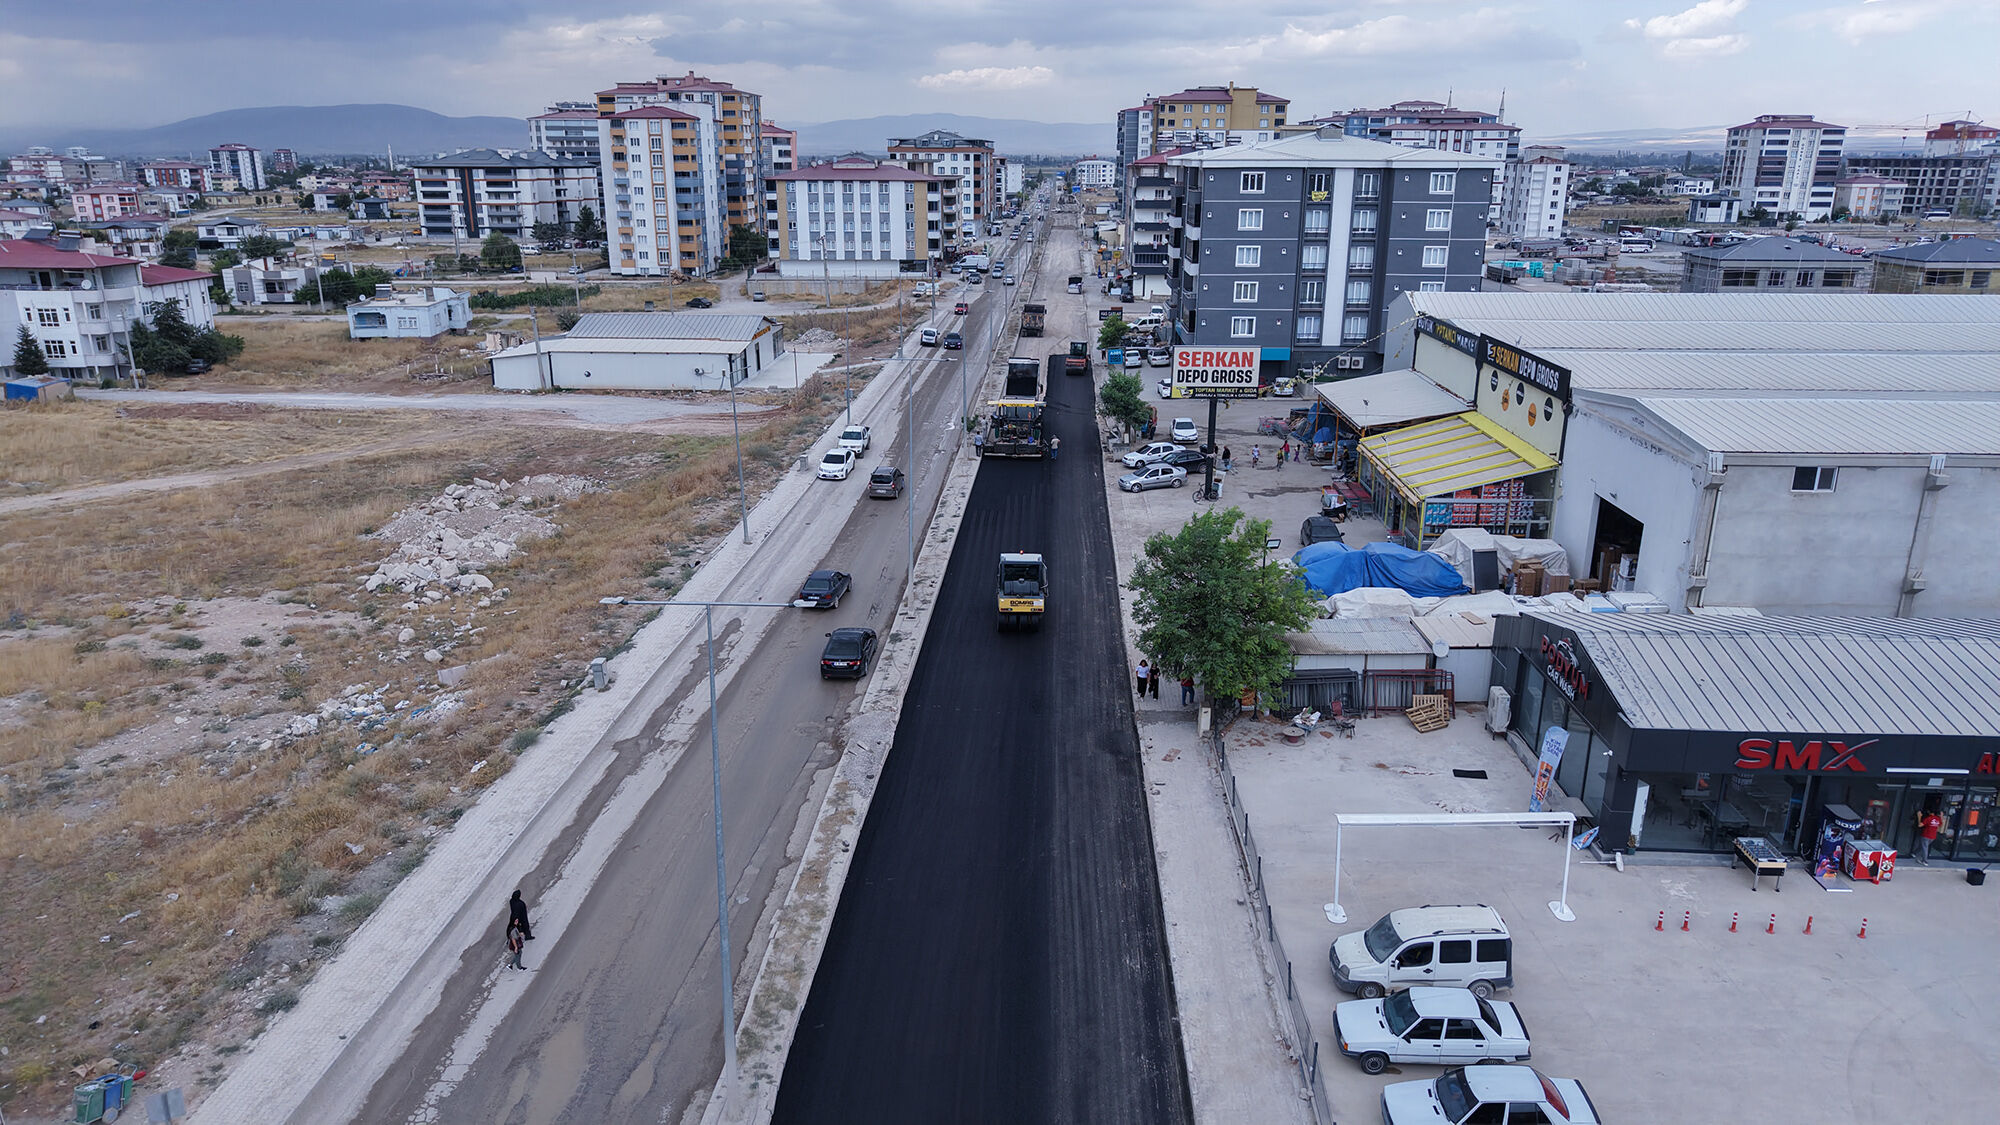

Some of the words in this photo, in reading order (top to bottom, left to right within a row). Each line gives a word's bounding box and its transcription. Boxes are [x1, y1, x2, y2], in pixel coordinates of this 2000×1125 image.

[1177, 369, 1209, 383] DEPO
[1211, 369, 1253, 384] GROSS
[1178, 351, 1254, 368] SERKAN
[1496, 346, 1520, 373] SERKAN
[1519, 355, 1537, 380] DEPO
[1536, 363, 1559, 392] GROSS
[1541, 634, 1590, 701] PODYUM
[1547, 664, 1560, 684] CAR
[1559, 676, 1575, 701] WASH
[1734, 738, 1879, 772] SMX
